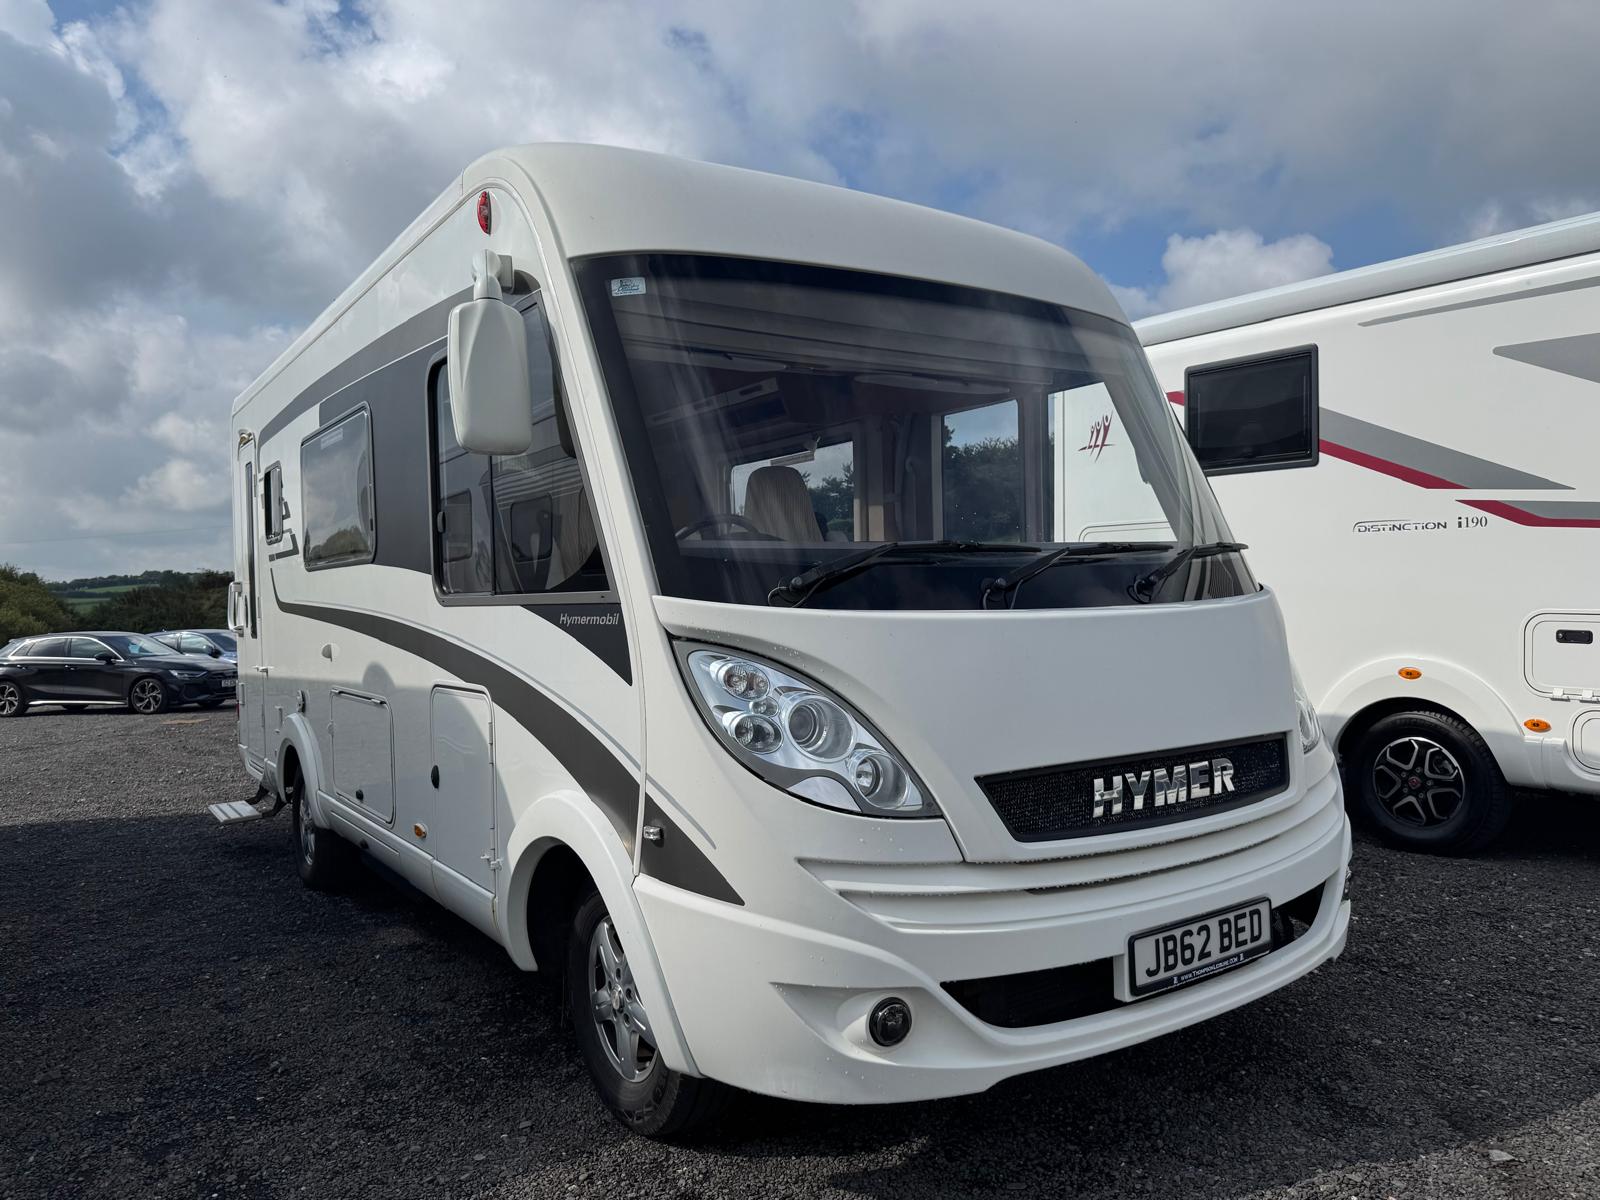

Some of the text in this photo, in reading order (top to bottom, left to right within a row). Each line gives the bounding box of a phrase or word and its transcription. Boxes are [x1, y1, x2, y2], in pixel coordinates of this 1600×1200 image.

[1457, 516, 1488, 528] i190
[560, 613, 620, 627] Hymermobil
[1092, 757, 1235, 818] HYMER
[1145, 908, 1263, 977] JB62 BED
